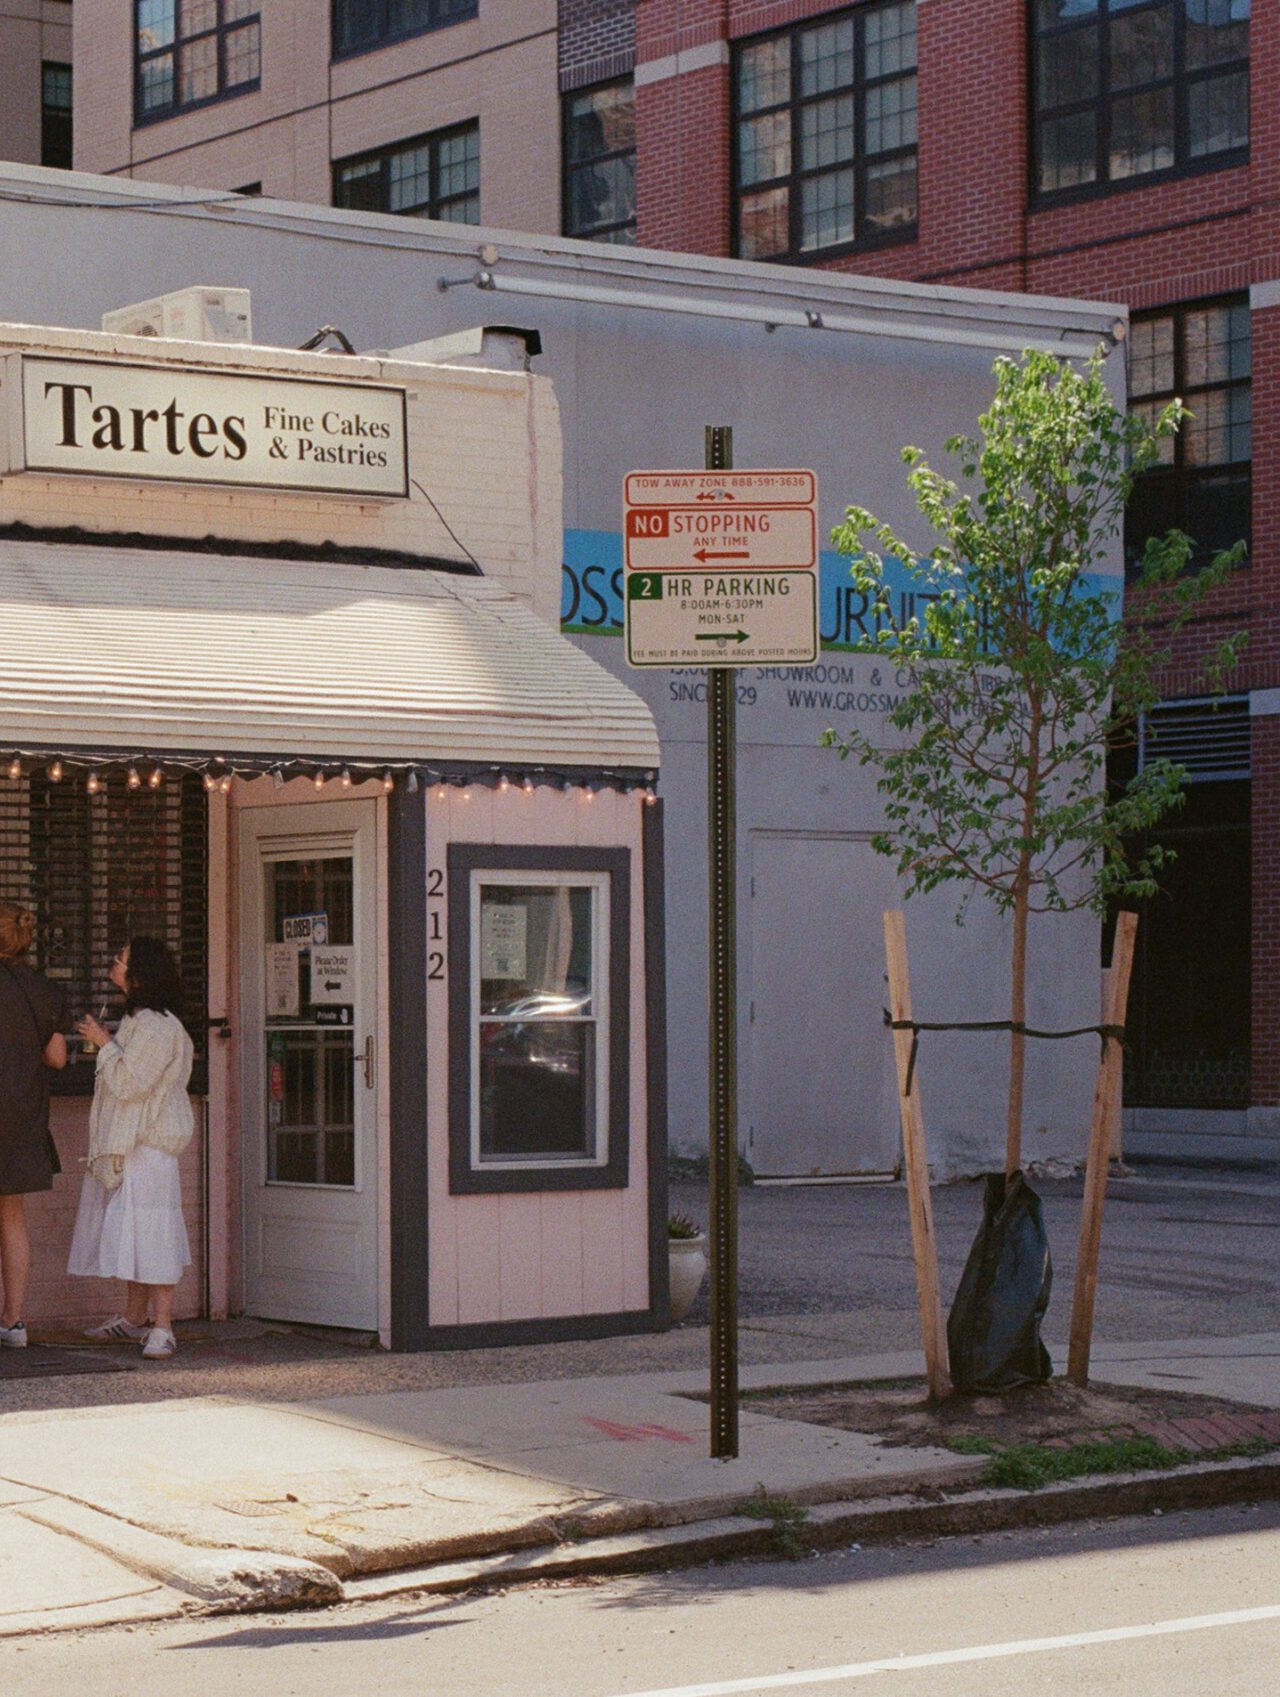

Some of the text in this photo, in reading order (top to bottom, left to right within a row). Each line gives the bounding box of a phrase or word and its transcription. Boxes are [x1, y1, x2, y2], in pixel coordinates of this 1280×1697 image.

[44, 382, 248, 460] Tartes
[263, 406, 391, 440] Fine Cakes
[268, 436, 388, 468] & Pastries
[636, 479, 659, 488] TOW
[664, 479, 695, 488] AWAY
[699, 478, 727, 487] ZONE
[635, 514, 770, 534] NO STOPPING
[693, 536, 748, 546] ANY TIME
[641, 578, 790, 596] 2 HR PARKING
[698, 614, 745, 624] MON-SAT
[670, 649, 678, 657] BE
[681, 649, 699, 657] PAID
[731, 648, 755, 656] ABOVE
[759, 648, 785, 656] POSTED
[756, 665, 853, 685] SHOWROOM
[870, 668, 882, 686] &
[670, 682, 708, 702] SINC
[427, 869, 445, 980] 2212
